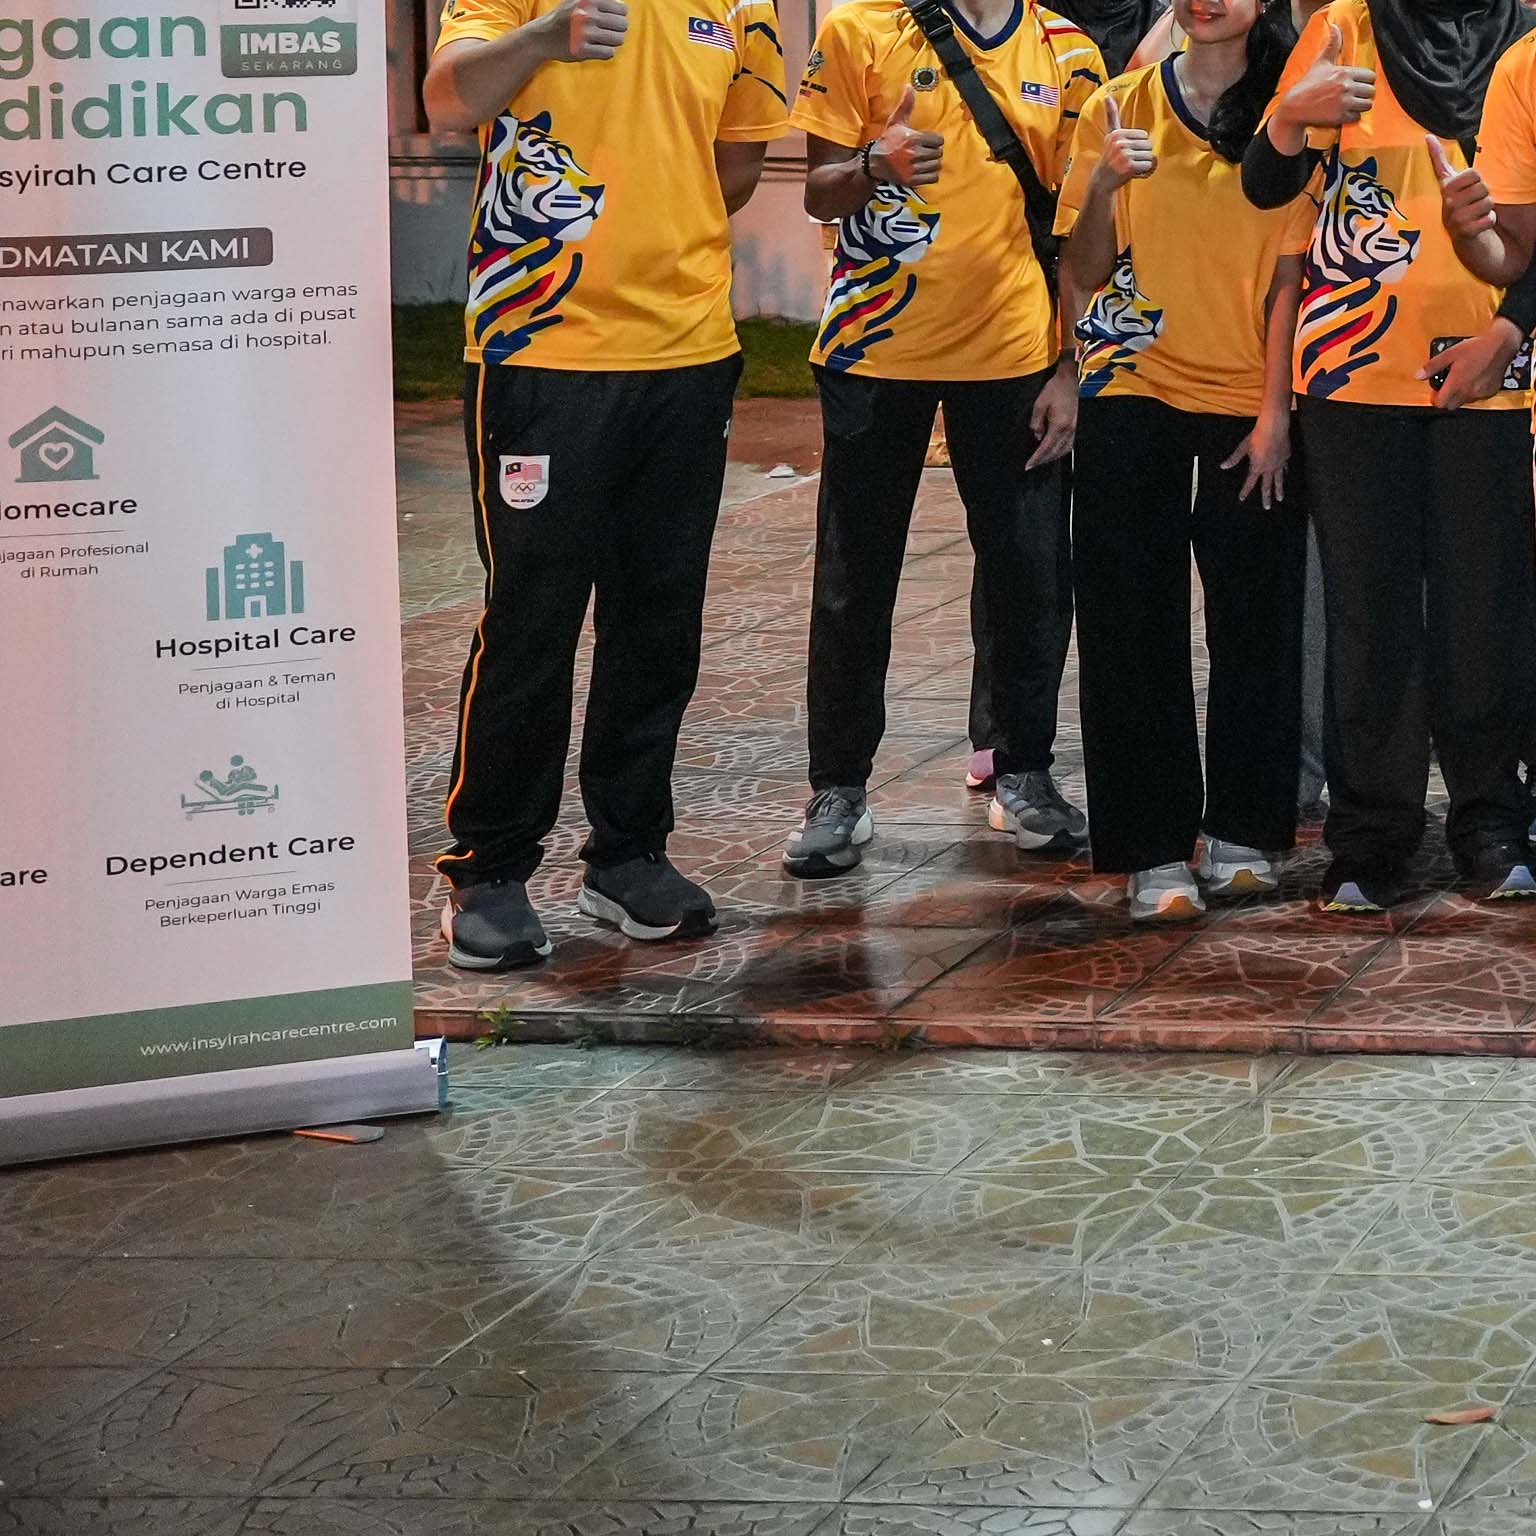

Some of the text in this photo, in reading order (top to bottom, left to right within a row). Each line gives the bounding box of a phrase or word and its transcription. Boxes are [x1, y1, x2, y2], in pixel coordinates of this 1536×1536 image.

[0, 15, 206, 80] gaan
[240, 31, 341, 55] IMBAS
[241, 59, 343, 72] SEKARANG
[0, 79, 308, 141] didikan
[0, 156, 307, 195] syirah Care Centre
[161, 236, 250, 263] KAMI
[112, 287, 226, 310] penjagaan
[232, 285, 296, 303] warga
[302, 282, 358, 298] emas
[19, 321, 64, 335] atau
[71, 316, 160, 334] bulanan
[166, 314, 223, 329] sama
[230, 307, 268, 326] ada
[274, 306, 294, 323] di
[300, 306, 356, 327] pusat
[21, 342, 125, 362] mahupun
[131, 339, 214, 356] semasa
[220, 333, 239, 351] di
[246, 330, 332, 351] hospital.
[0, 498, 138, 520] omecare
[0, 541, 149, 564] jagaan Profesional
[20, 564, 99, 579] di Rumah
[156, 624, 357, 660] Hospital Care
[178, 671, 336, 696] Penjagaan & Teman
[215, 691, 301, 710] di Hospital
[105, 834, 356, 877] Dependent Care
[0, 869, 48, 886] are
[145, 879, 336, 912] Penjagaan Warga Emas
[159, 899, 322, 928] Berkeperluan Tinggi
